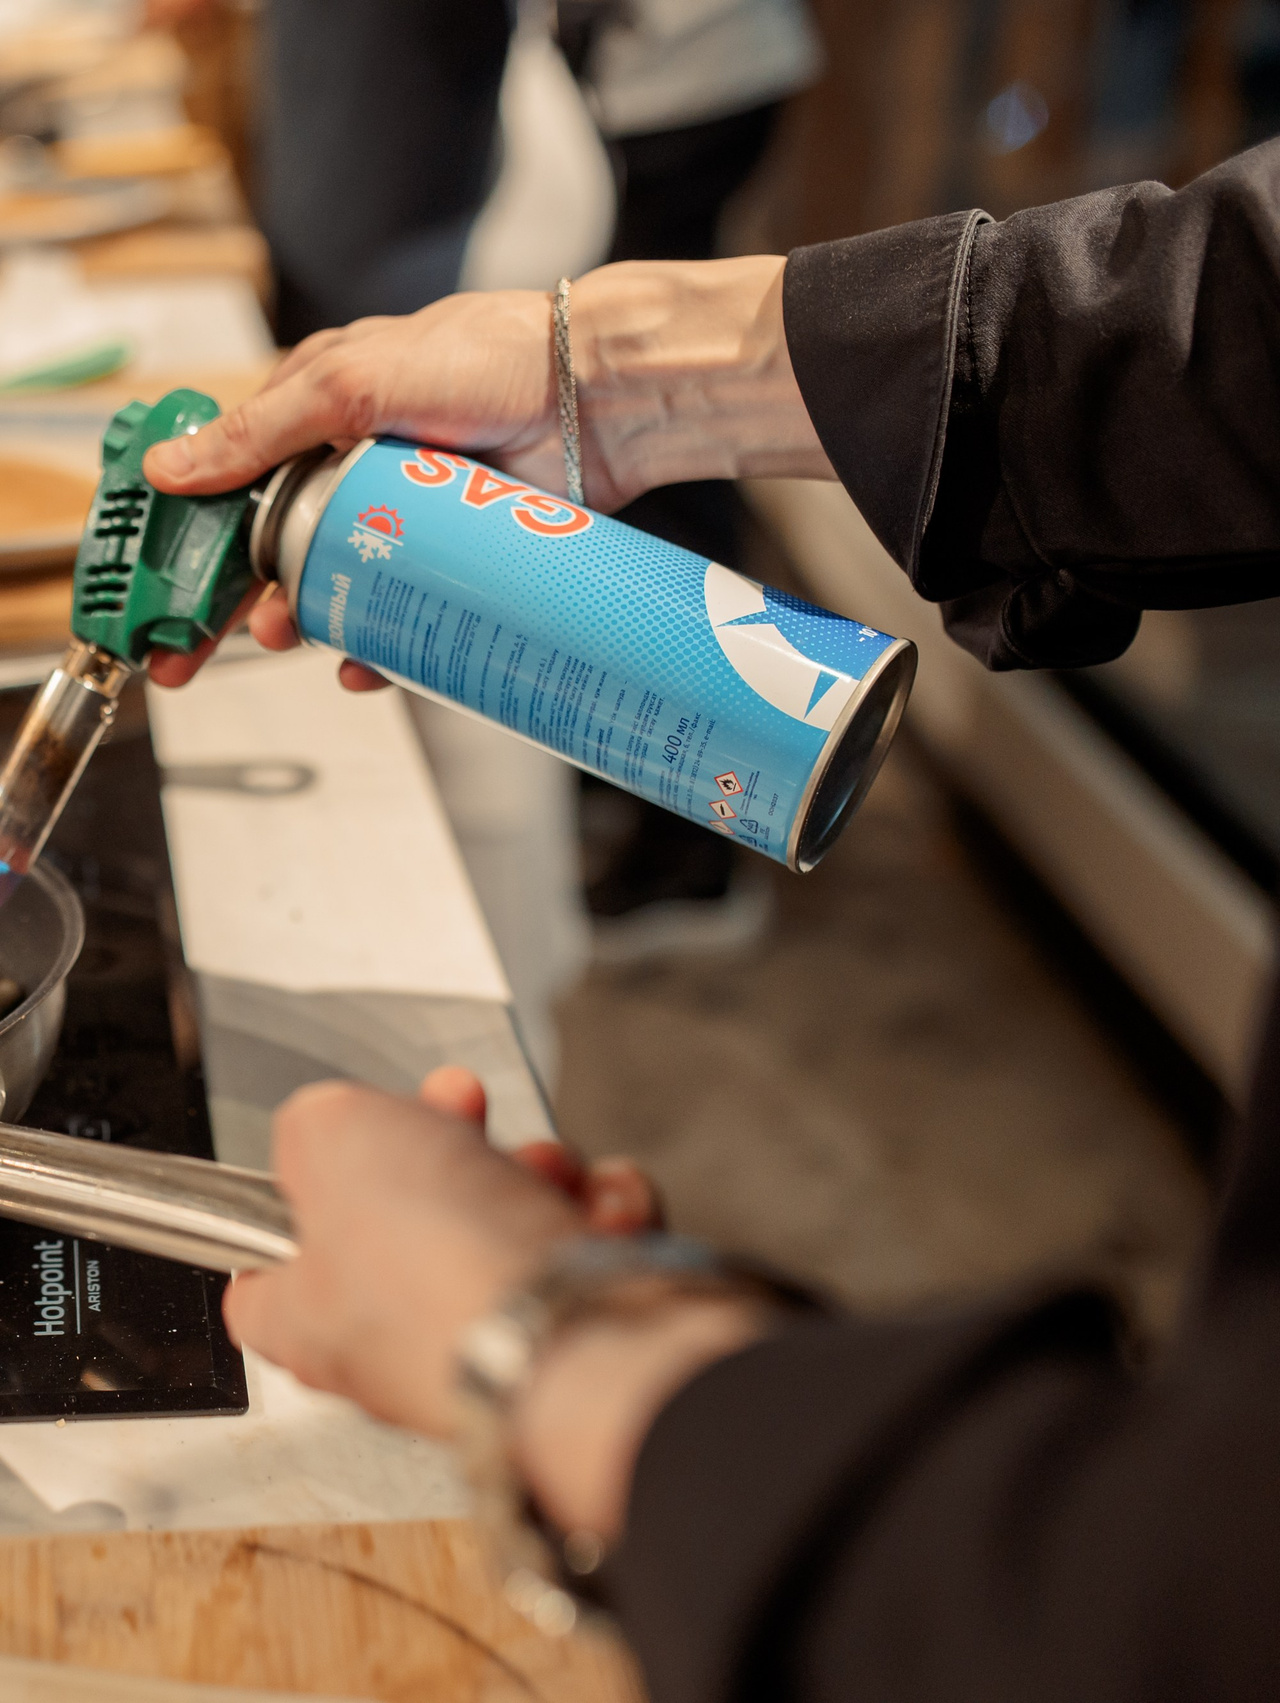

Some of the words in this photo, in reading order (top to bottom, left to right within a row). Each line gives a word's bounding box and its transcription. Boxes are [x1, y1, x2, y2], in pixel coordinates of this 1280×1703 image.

[401, 446, 594, 538] GAS
[661, 734, 683, 765] 400
[676, 717, 689, 736] мл
[32, 1240, 72, 1336] Hotpoint
[86, 1259, 101, 1312] ARISTON
